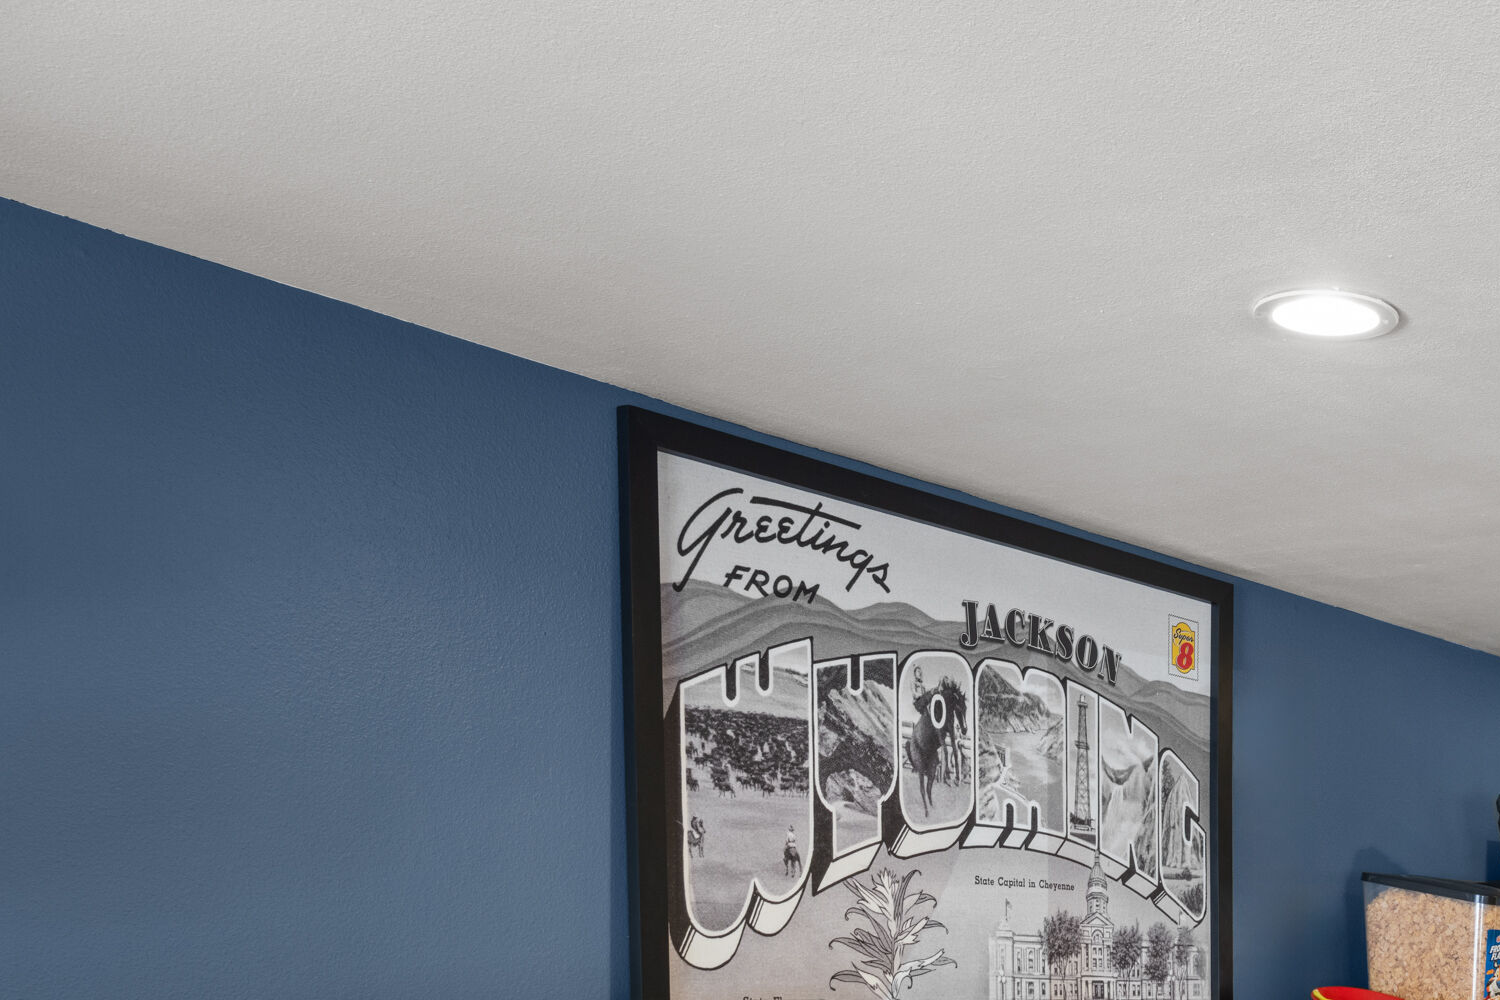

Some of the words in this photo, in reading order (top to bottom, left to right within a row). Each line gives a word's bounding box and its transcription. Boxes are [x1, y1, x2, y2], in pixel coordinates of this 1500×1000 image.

[672, 487, 891, 594] Greetings
[723, 564, 820, 605] FROM
[959, 599, 1123, 686] JACKSON
[1173, 627, 1194, 645] Super
[1176, 642, 1194, 670] 8
[670, 637, 1208, 969] WYOMING
[974, 875, 995, 886] State
[997, 876, 1026, 889] Capital
[1028, 879, 1036, 888] in
[1039, 879, 1075, 892] Cheyenne
